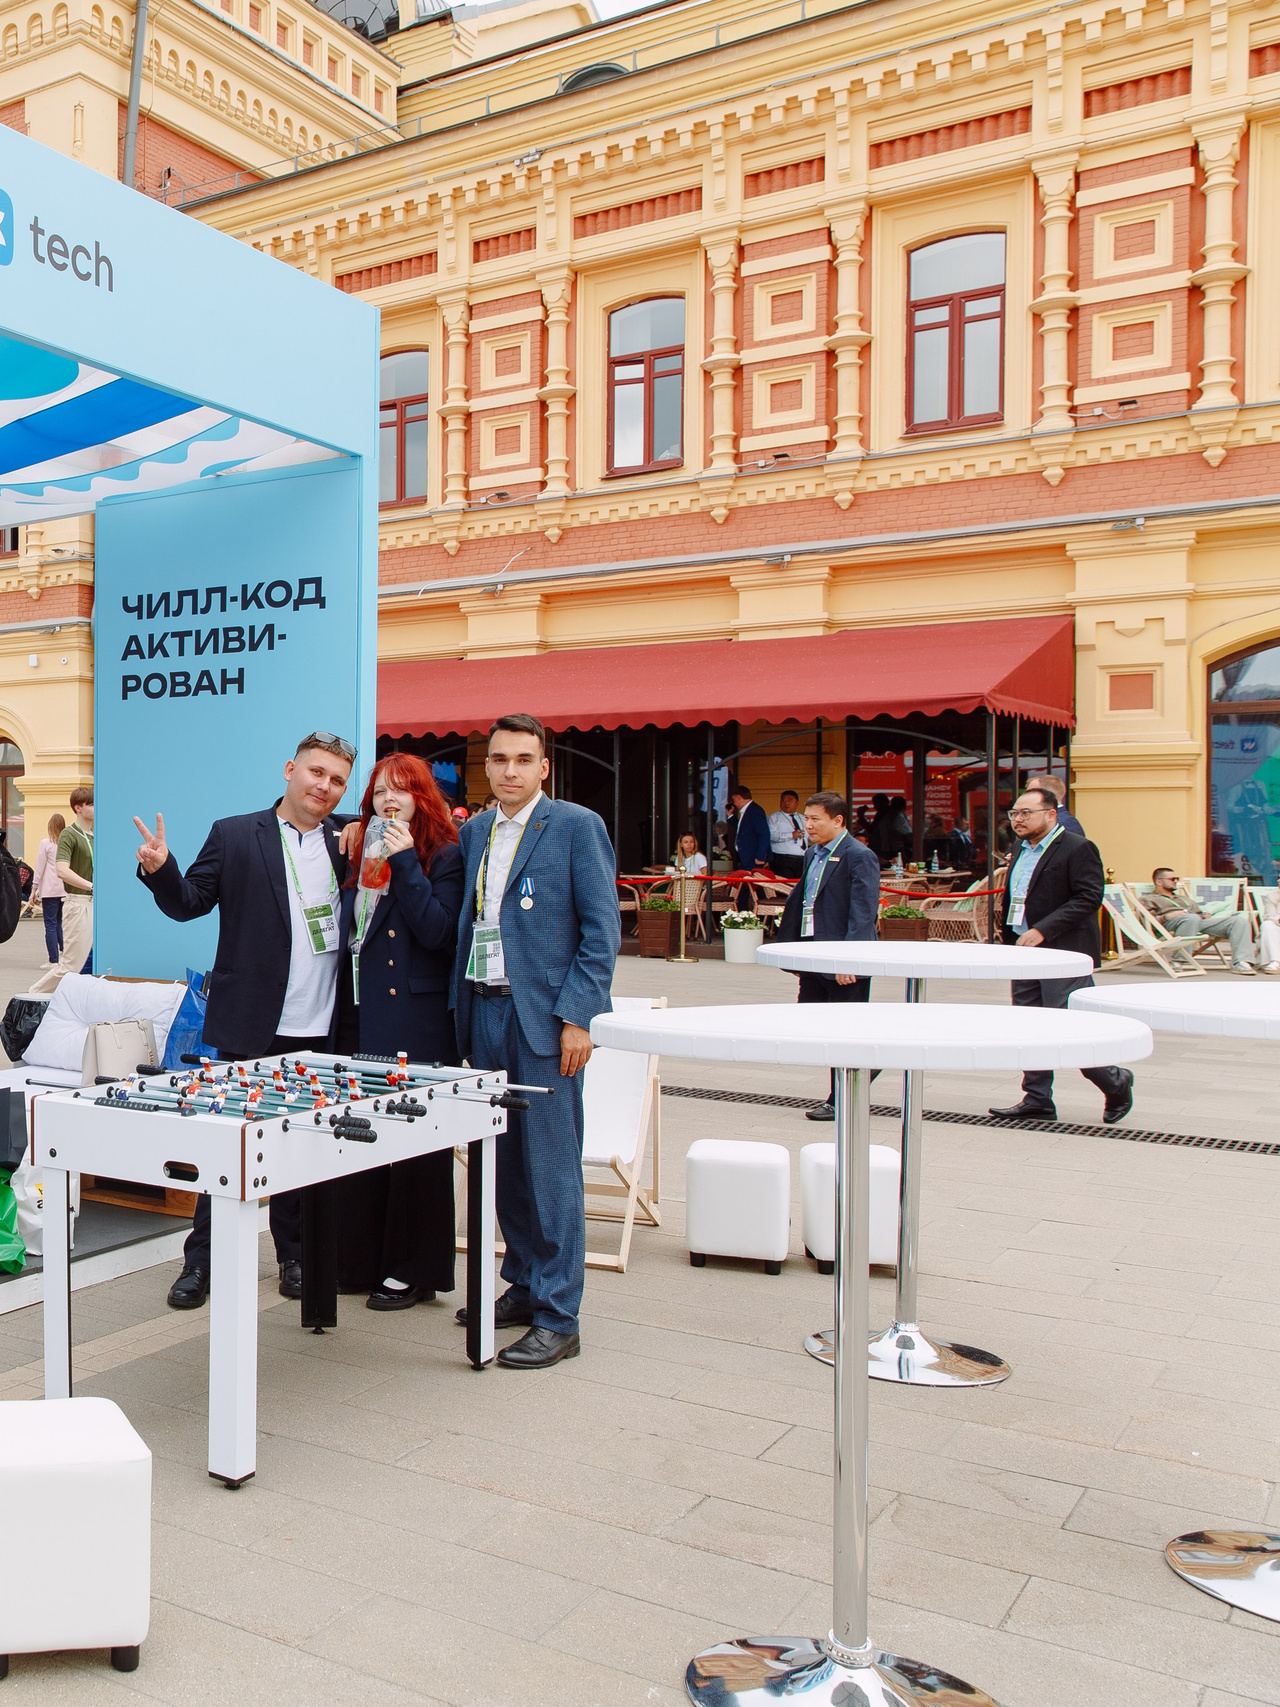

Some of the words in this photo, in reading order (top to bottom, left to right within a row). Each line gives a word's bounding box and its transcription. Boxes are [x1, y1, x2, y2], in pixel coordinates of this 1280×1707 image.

[29, 215, 113, 292] tech
[122, 576, 326, 621] ЧИЛЛ-КОД
[120, 623, 287, 661] АКТИВИ-
[122, 667, 245, 700] РОВАН
